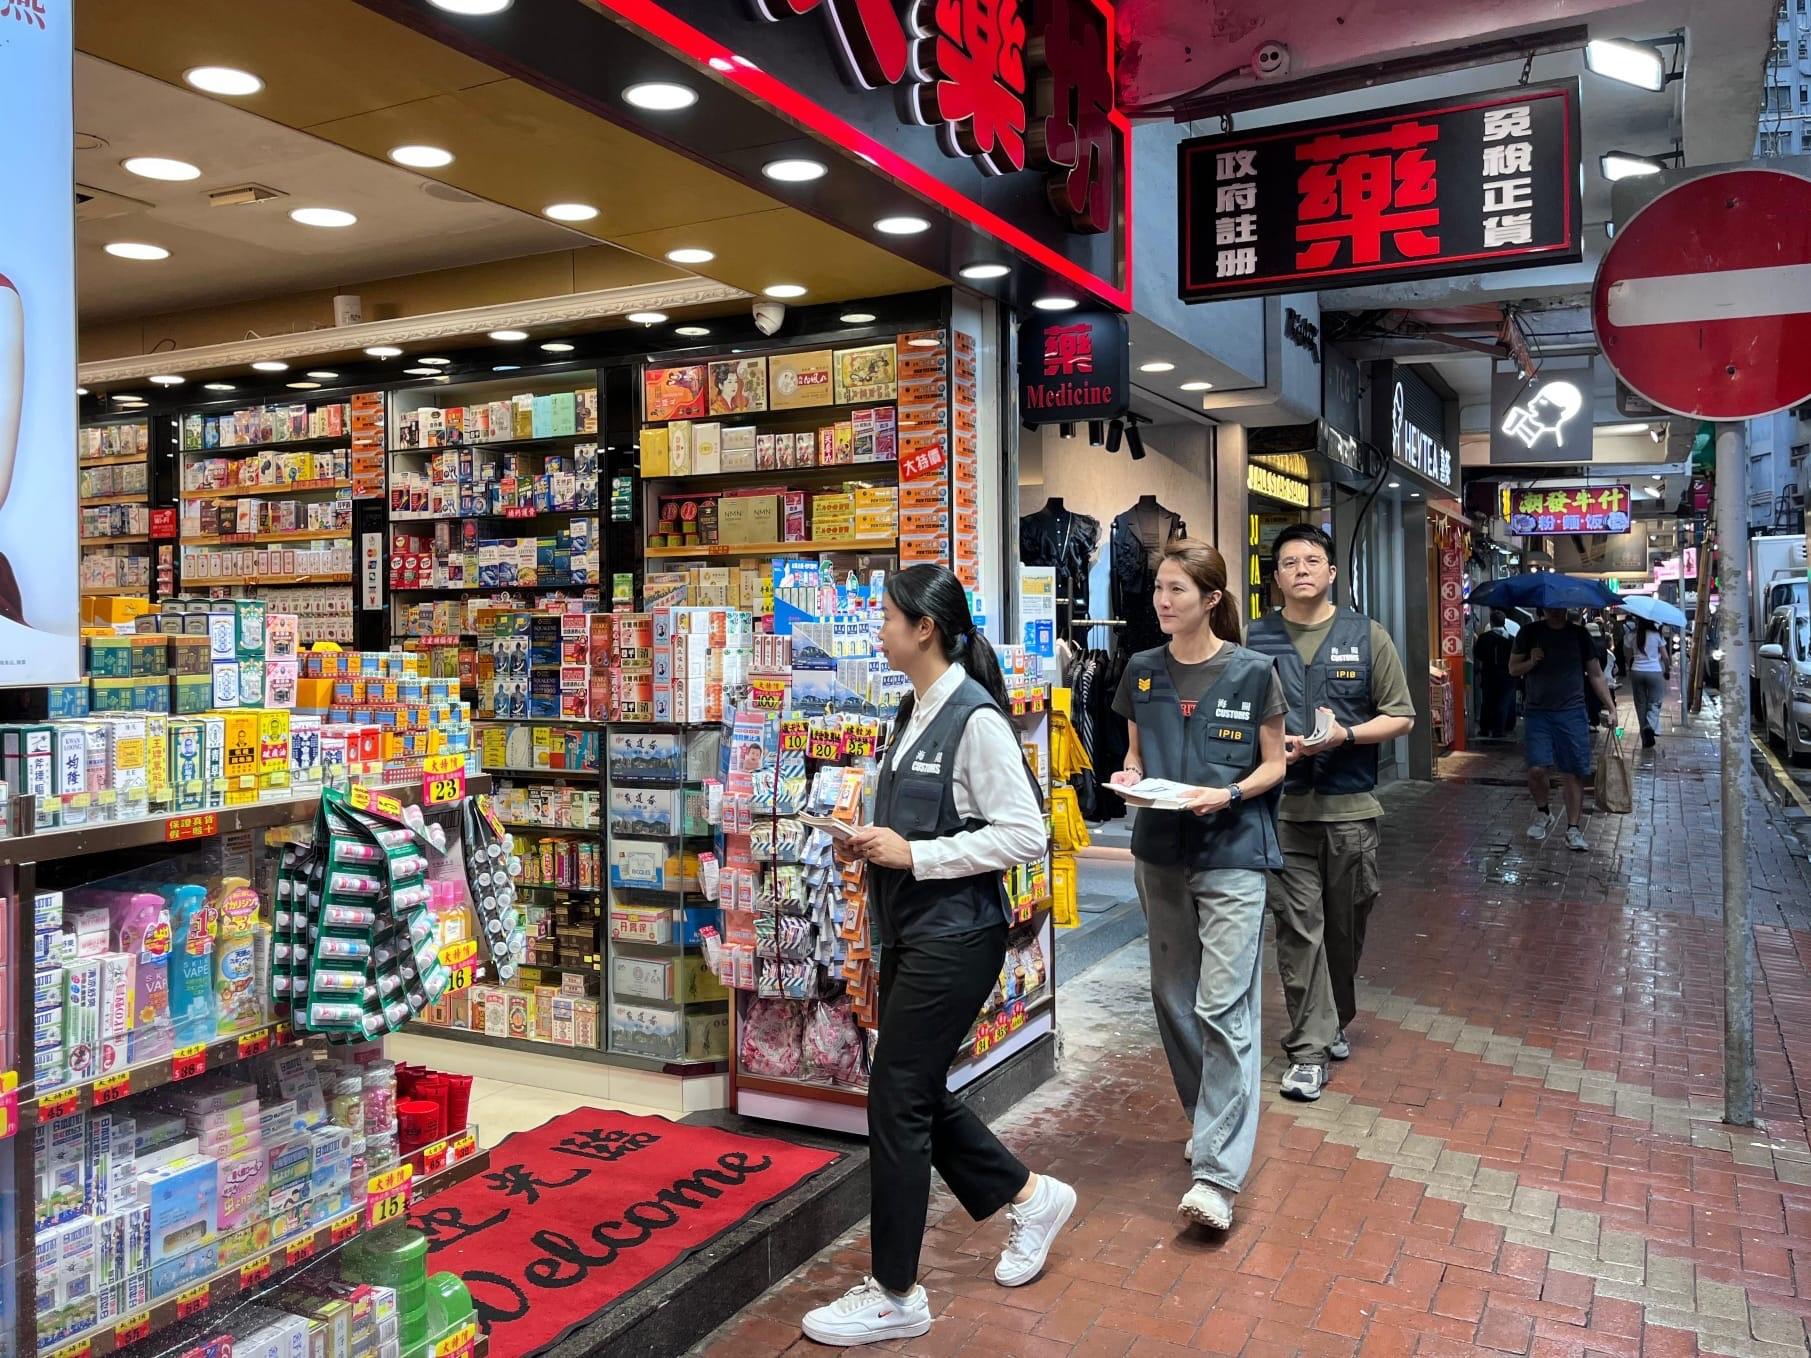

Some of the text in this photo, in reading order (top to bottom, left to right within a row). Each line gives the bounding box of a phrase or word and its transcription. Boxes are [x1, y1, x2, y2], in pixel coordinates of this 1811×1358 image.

[1295, 121, 1440, 271] 藥
[1043, 323, 1093, 376] 藥
[1027, 381, 1112, 408] Medicine
[1404, 420, 1438, 480] HEYTEA
[903, 453, 943, 476] 大特價
[1330, 654, 1359, 662] CUSTOMS
[1336, 670, 1356, 679] IPIB
[1215, 708, 1250, 721] CUSTOMS
[787, 735, 802, 748] 10
[1219, 729, 1242, 740] IPIB
[816, 744, 832, 757] 20
[849, 743, 864, 756] 25
[431, 759, 458, 771] 大特價
[435, 778, 457, 801] 23
[444, 946, 470, 964] 大特價
[184, 964, 209, 978] VAPE
[448, 968, 465, 990] 16
[375, 1170, 405, 1191] 大特價
[380, 1196, 399, 1220] 15
